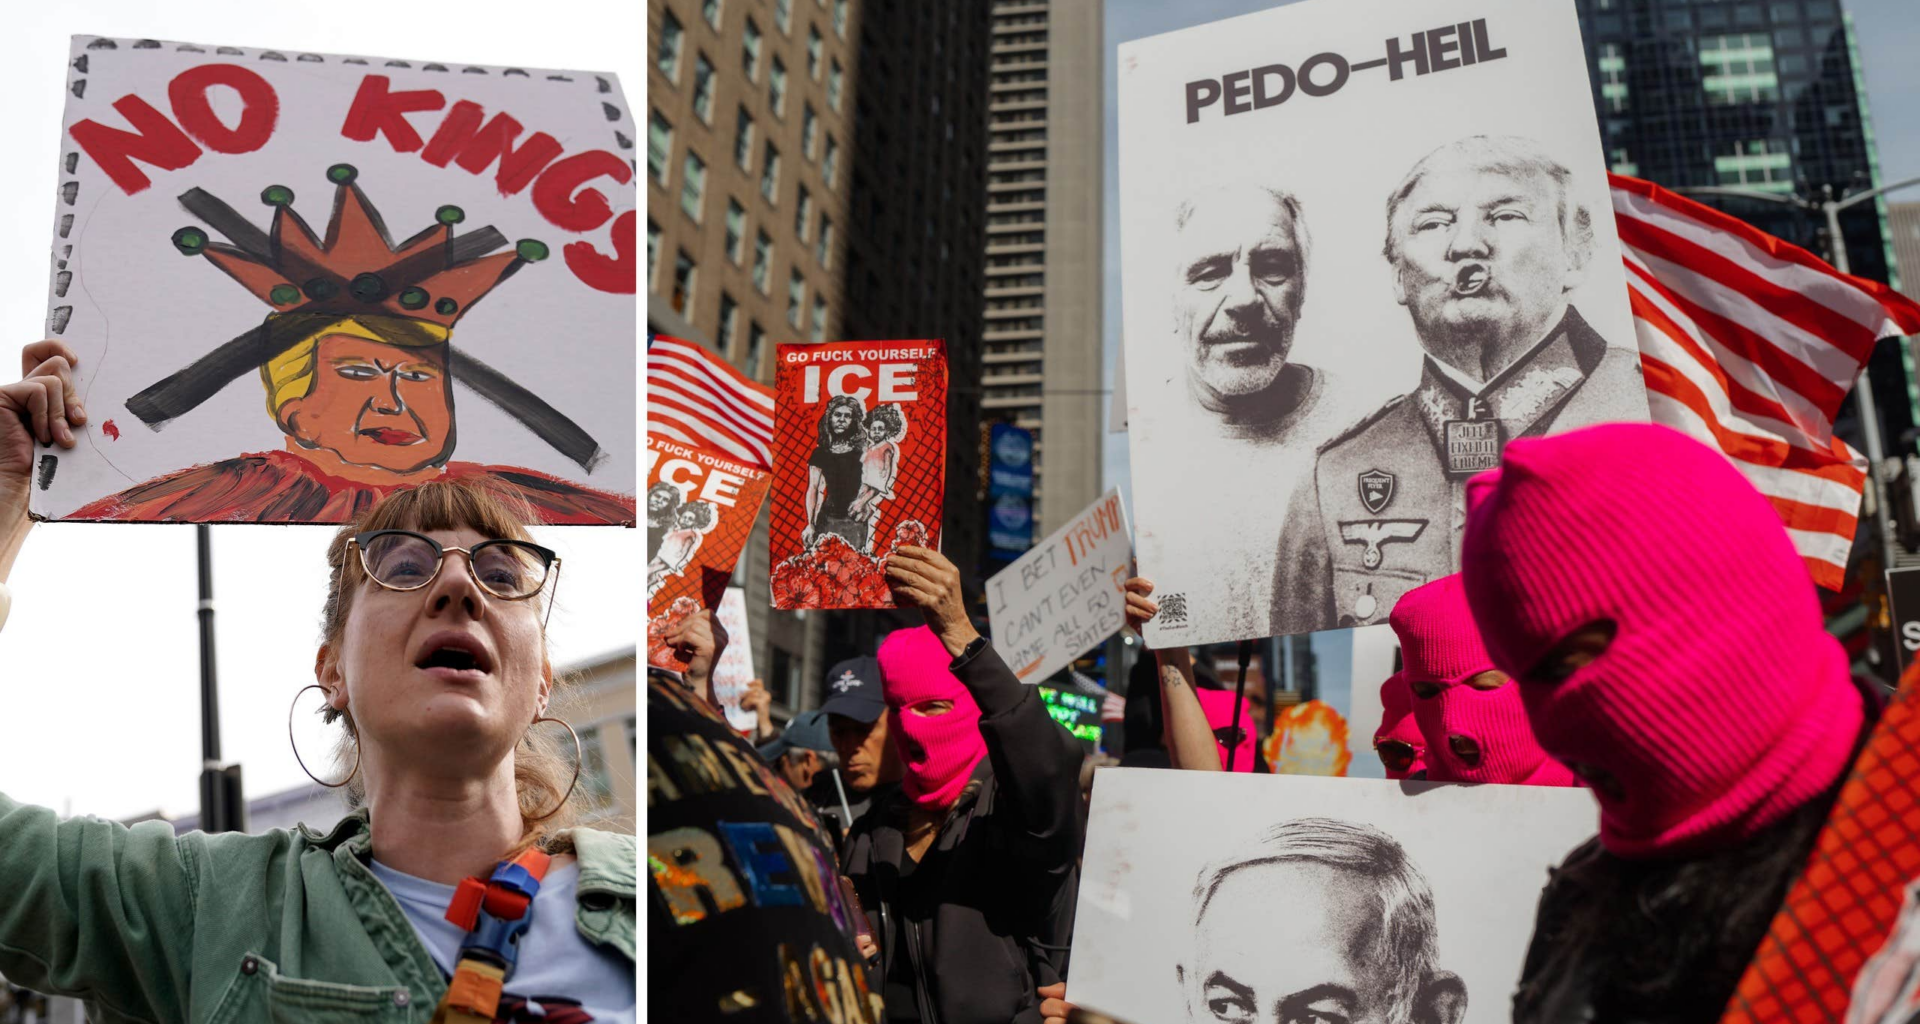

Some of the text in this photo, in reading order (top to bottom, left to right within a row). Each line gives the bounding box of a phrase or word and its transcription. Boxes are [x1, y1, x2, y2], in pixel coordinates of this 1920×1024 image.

[68, 63, 279, 196] NO
[786, 348, 938, 363] GO FUCK YOURSELF
[804, 363, 918, 404] ICE
[647, 449, 746, 508] ICE
[656, 440, 694, 459] FUCK
[697, 453, 766, 481] YOURSELF
[994, 580, 1007, 615] I
[1020, 545, 1056, 591] BET
[1063, 494, 1120, 566] TRUMP
[1058, 554, 1107, 609] EVEN
[1011, 590, 1111, 669] AME ALL 50
[1065, 608, 1121, 658] STATES
